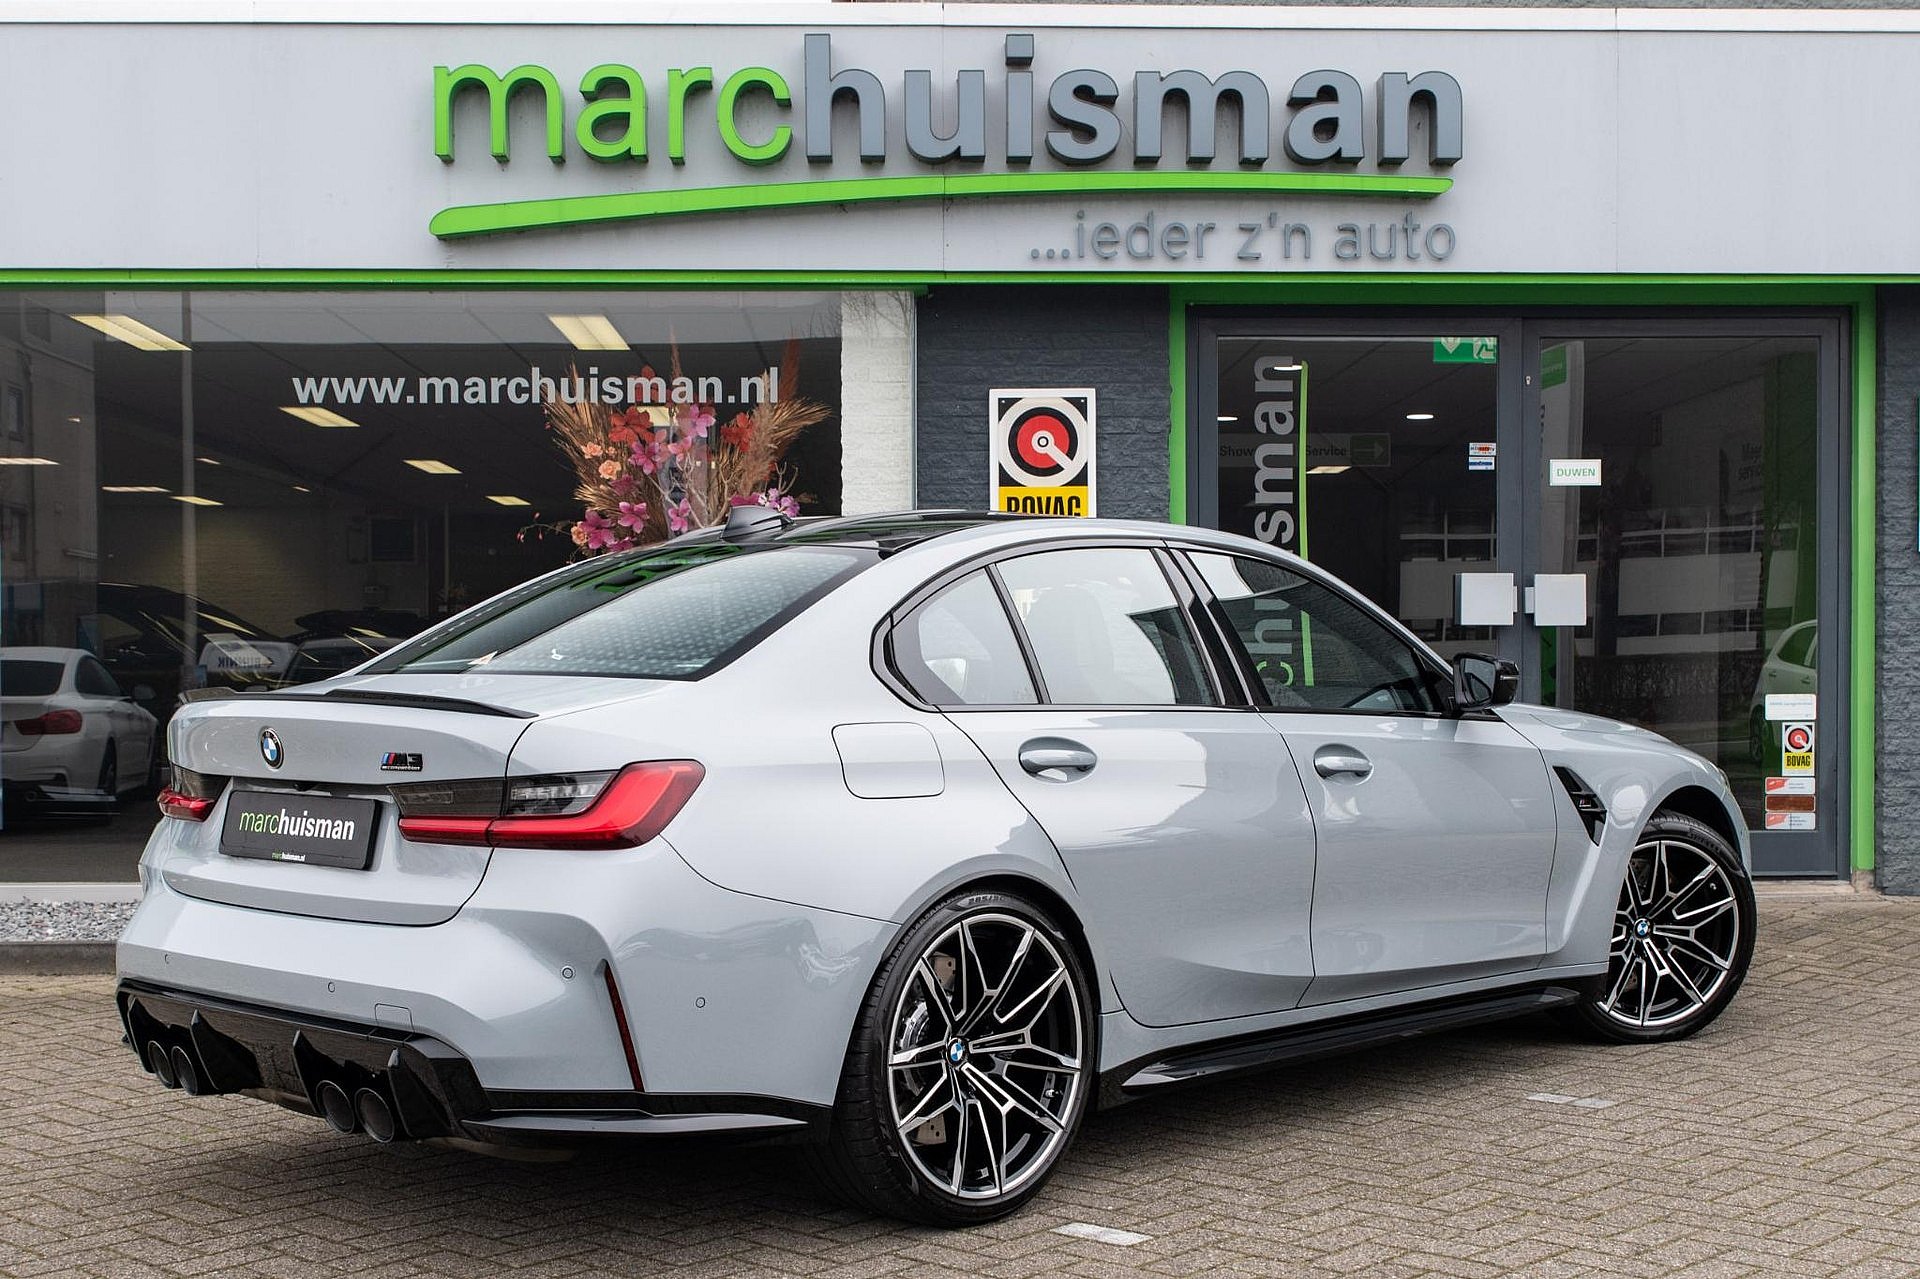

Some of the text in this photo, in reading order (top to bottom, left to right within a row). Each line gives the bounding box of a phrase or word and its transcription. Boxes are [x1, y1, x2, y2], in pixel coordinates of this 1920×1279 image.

[434, 34, 1463, 166] marchuisman
[1237, 212, 1311, 260] z'n
[1334, 210, 1456, 260] auto
[292, 367, 779, 404] www.marchuisman.nl
[1556, 468, 1596, 477] DUWEN
[1786, 755, 1811, 767] BOVAG
[239, 809, 355, 840] marchuisman
